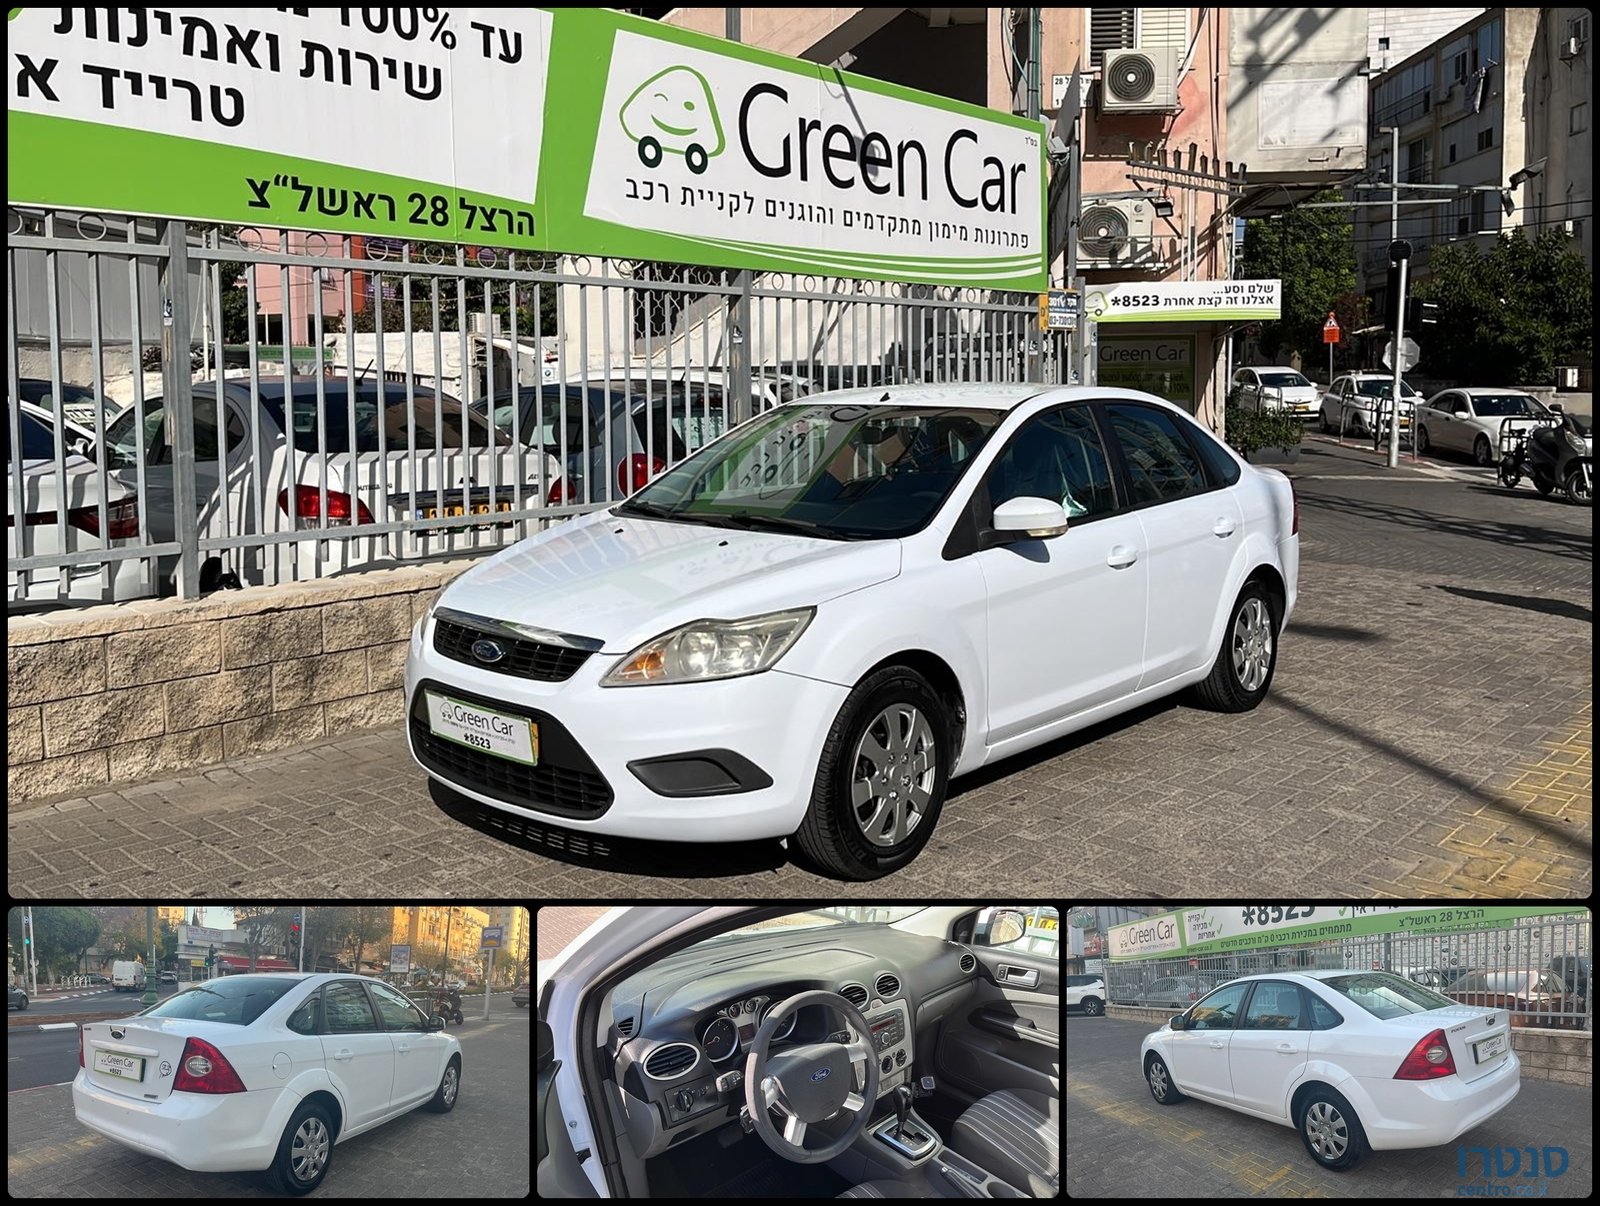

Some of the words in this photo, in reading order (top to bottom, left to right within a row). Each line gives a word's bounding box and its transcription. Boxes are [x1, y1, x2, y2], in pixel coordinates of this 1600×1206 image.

[53, 8, 280, 73] ואמינות
[471, 21, 521, 64] עד
[299, 40, 442, 101] שירות
[82, 63, 245, 127] טרייד
[739, 83, 928, 201] Green
[945, 129, 1026, 215] Car
[625, 178, 670, 204] רכב
[681, 185, 755, 214] לקניית
[408, 193, 449, 227] 28
[459, 197, 535, 237] הרצל
[764, 199, 834, 226] והוגנים
[843, 210, 921, 237] מתקדמים
[928, 221, 968, 242] מימון
[974, 227, 1029, 249] פתרונות
[1248, 283, 1274, 293] שלם
[1163, 297, 1195, 306] אחרת
[1198, 296, 1222, 307] קצת
[1225, 296, 1238, 305] זה
[1241, 295, 1274, 305] אצלנו
[1100, 345, 1151, 361] Green
[1156, 344, 1185, 361] Car
[453, 705, 490, 731] Green
[491, 716, 514, 736] Car
[1439, 911, 1453, 923] 28
[1456, 909, 1485, 920] הרצל
[1129, 927, 1156, 945] Green
[1156, 921, 1175, 940] Car
[1291, 928, 1318, 939] במכירת
[1320, 923, 1352, 935] מתמחים
[107, 1054, 124, 1066] Green
[123, 1058, 135, 1068] Car
